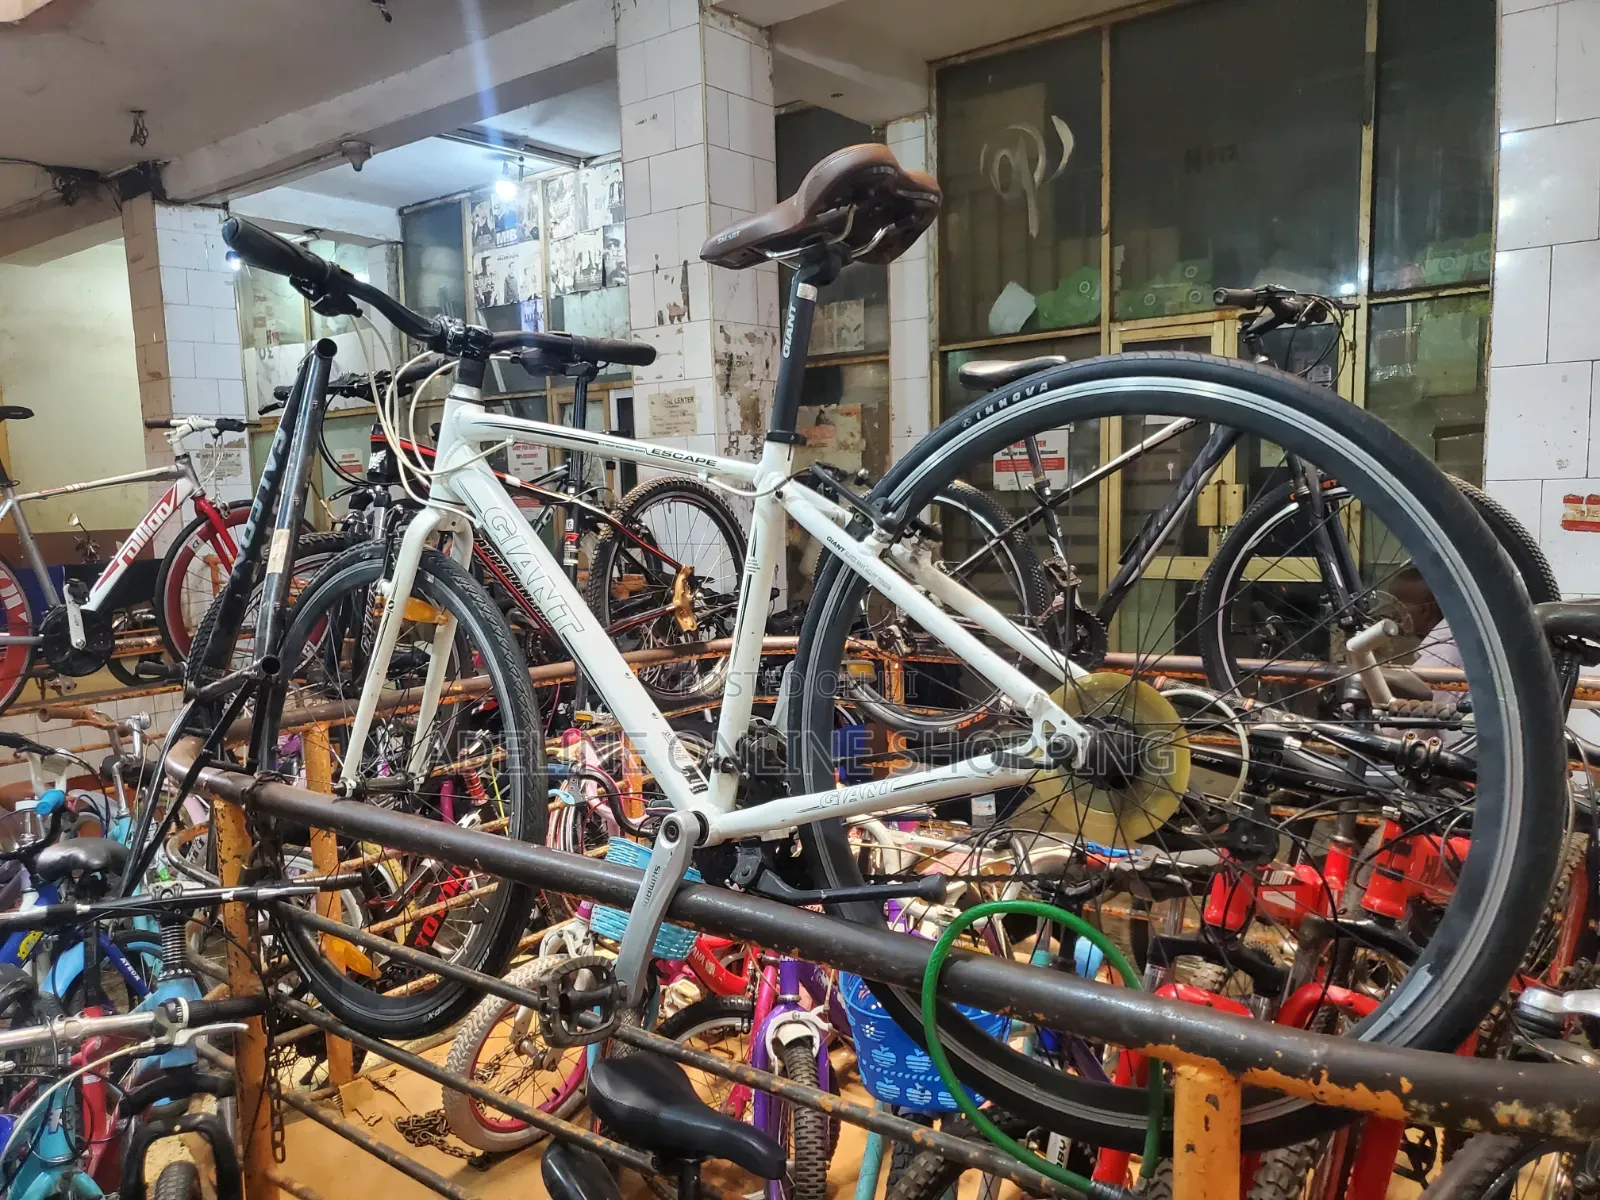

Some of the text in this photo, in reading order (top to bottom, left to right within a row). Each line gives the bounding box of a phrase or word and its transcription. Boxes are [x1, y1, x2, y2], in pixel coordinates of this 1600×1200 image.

[717, 230, 740, 244] SMART
[782, 304, 797, 359] GIANT
[976, 382, 1048, 420] INNOVA
[651, 443, 718, 467] ESCAPE
[826, 535, 846, 553] GIANT
[484, 507, 585, 633] GIANT
[820, 778, 902, 808] GIANT
